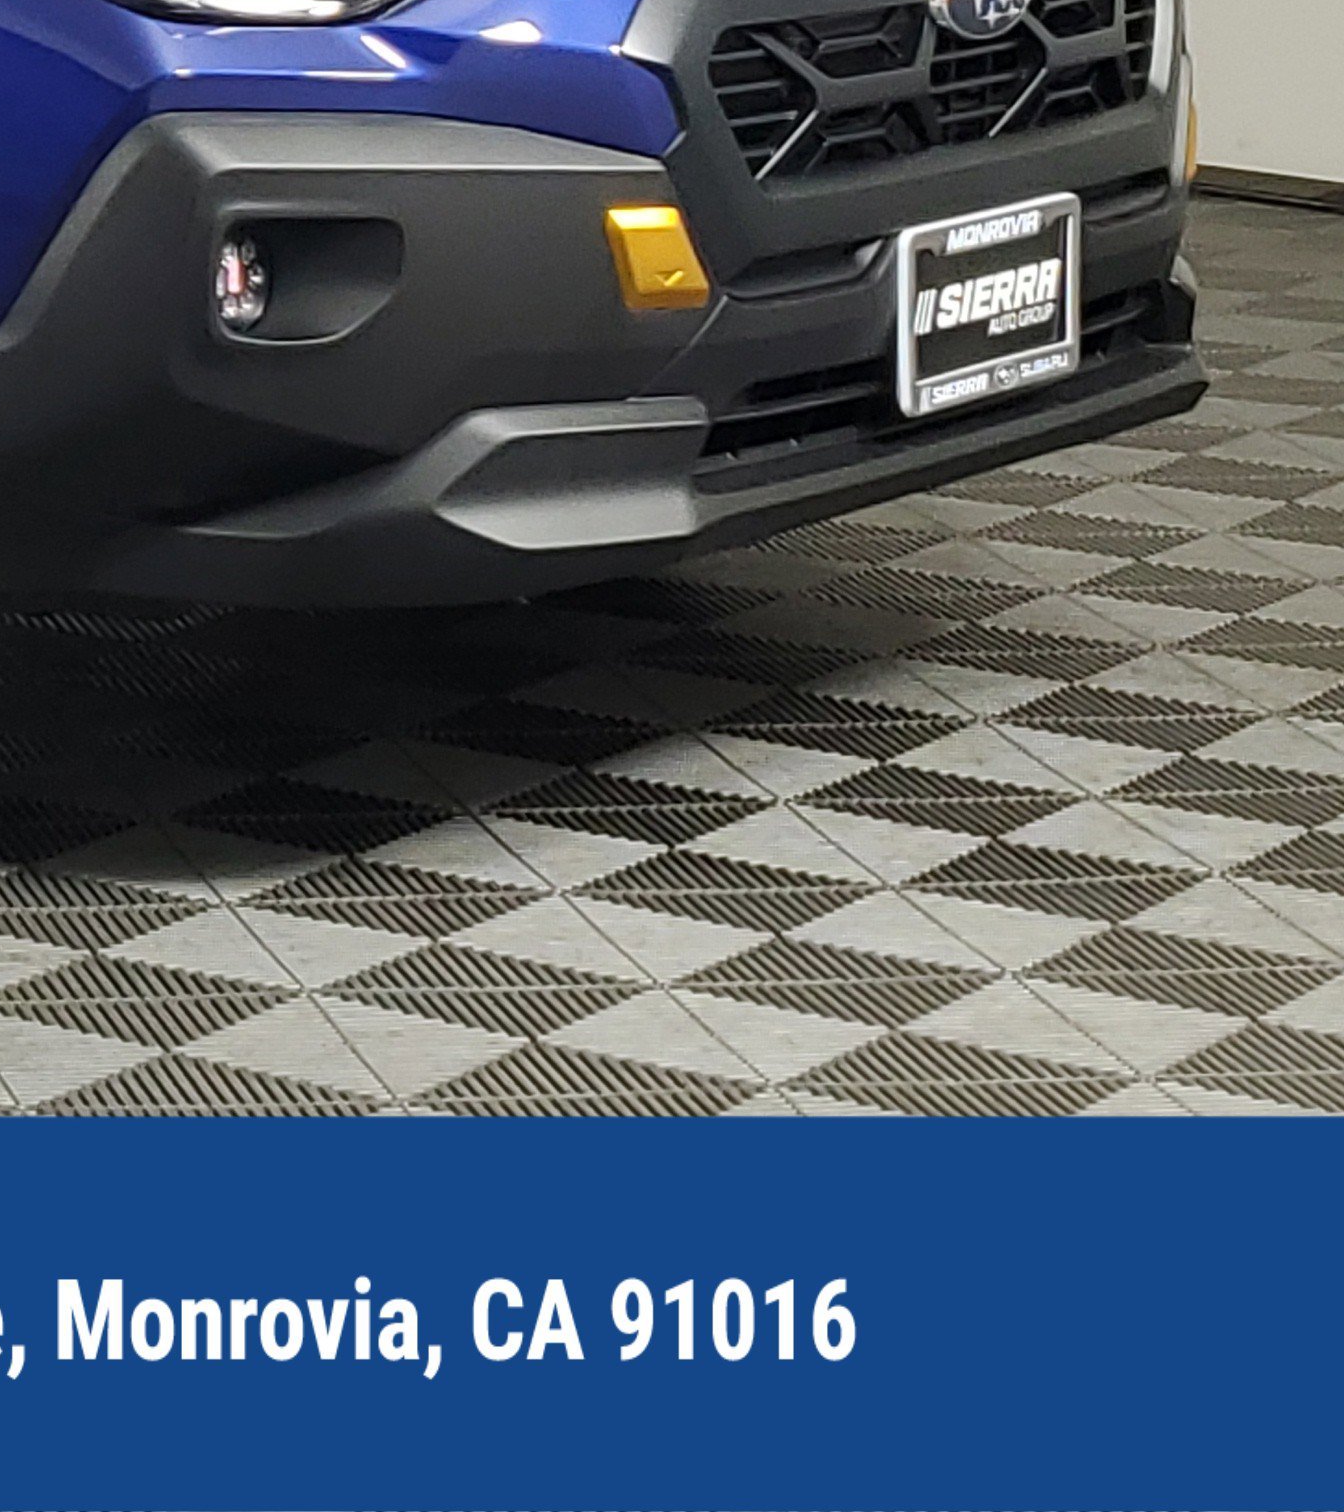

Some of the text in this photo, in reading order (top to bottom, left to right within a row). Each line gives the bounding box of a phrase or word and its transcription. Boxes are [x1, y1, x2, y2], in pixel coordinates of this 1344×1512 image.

[944, 209, 1042, 255] MONROVIA
[936, 257, 1062, 330] SIERRA
[987, 302, 1057, 337] AUTO GROUP
[931, 352, 1069, 405] SIERRA SUBARU
